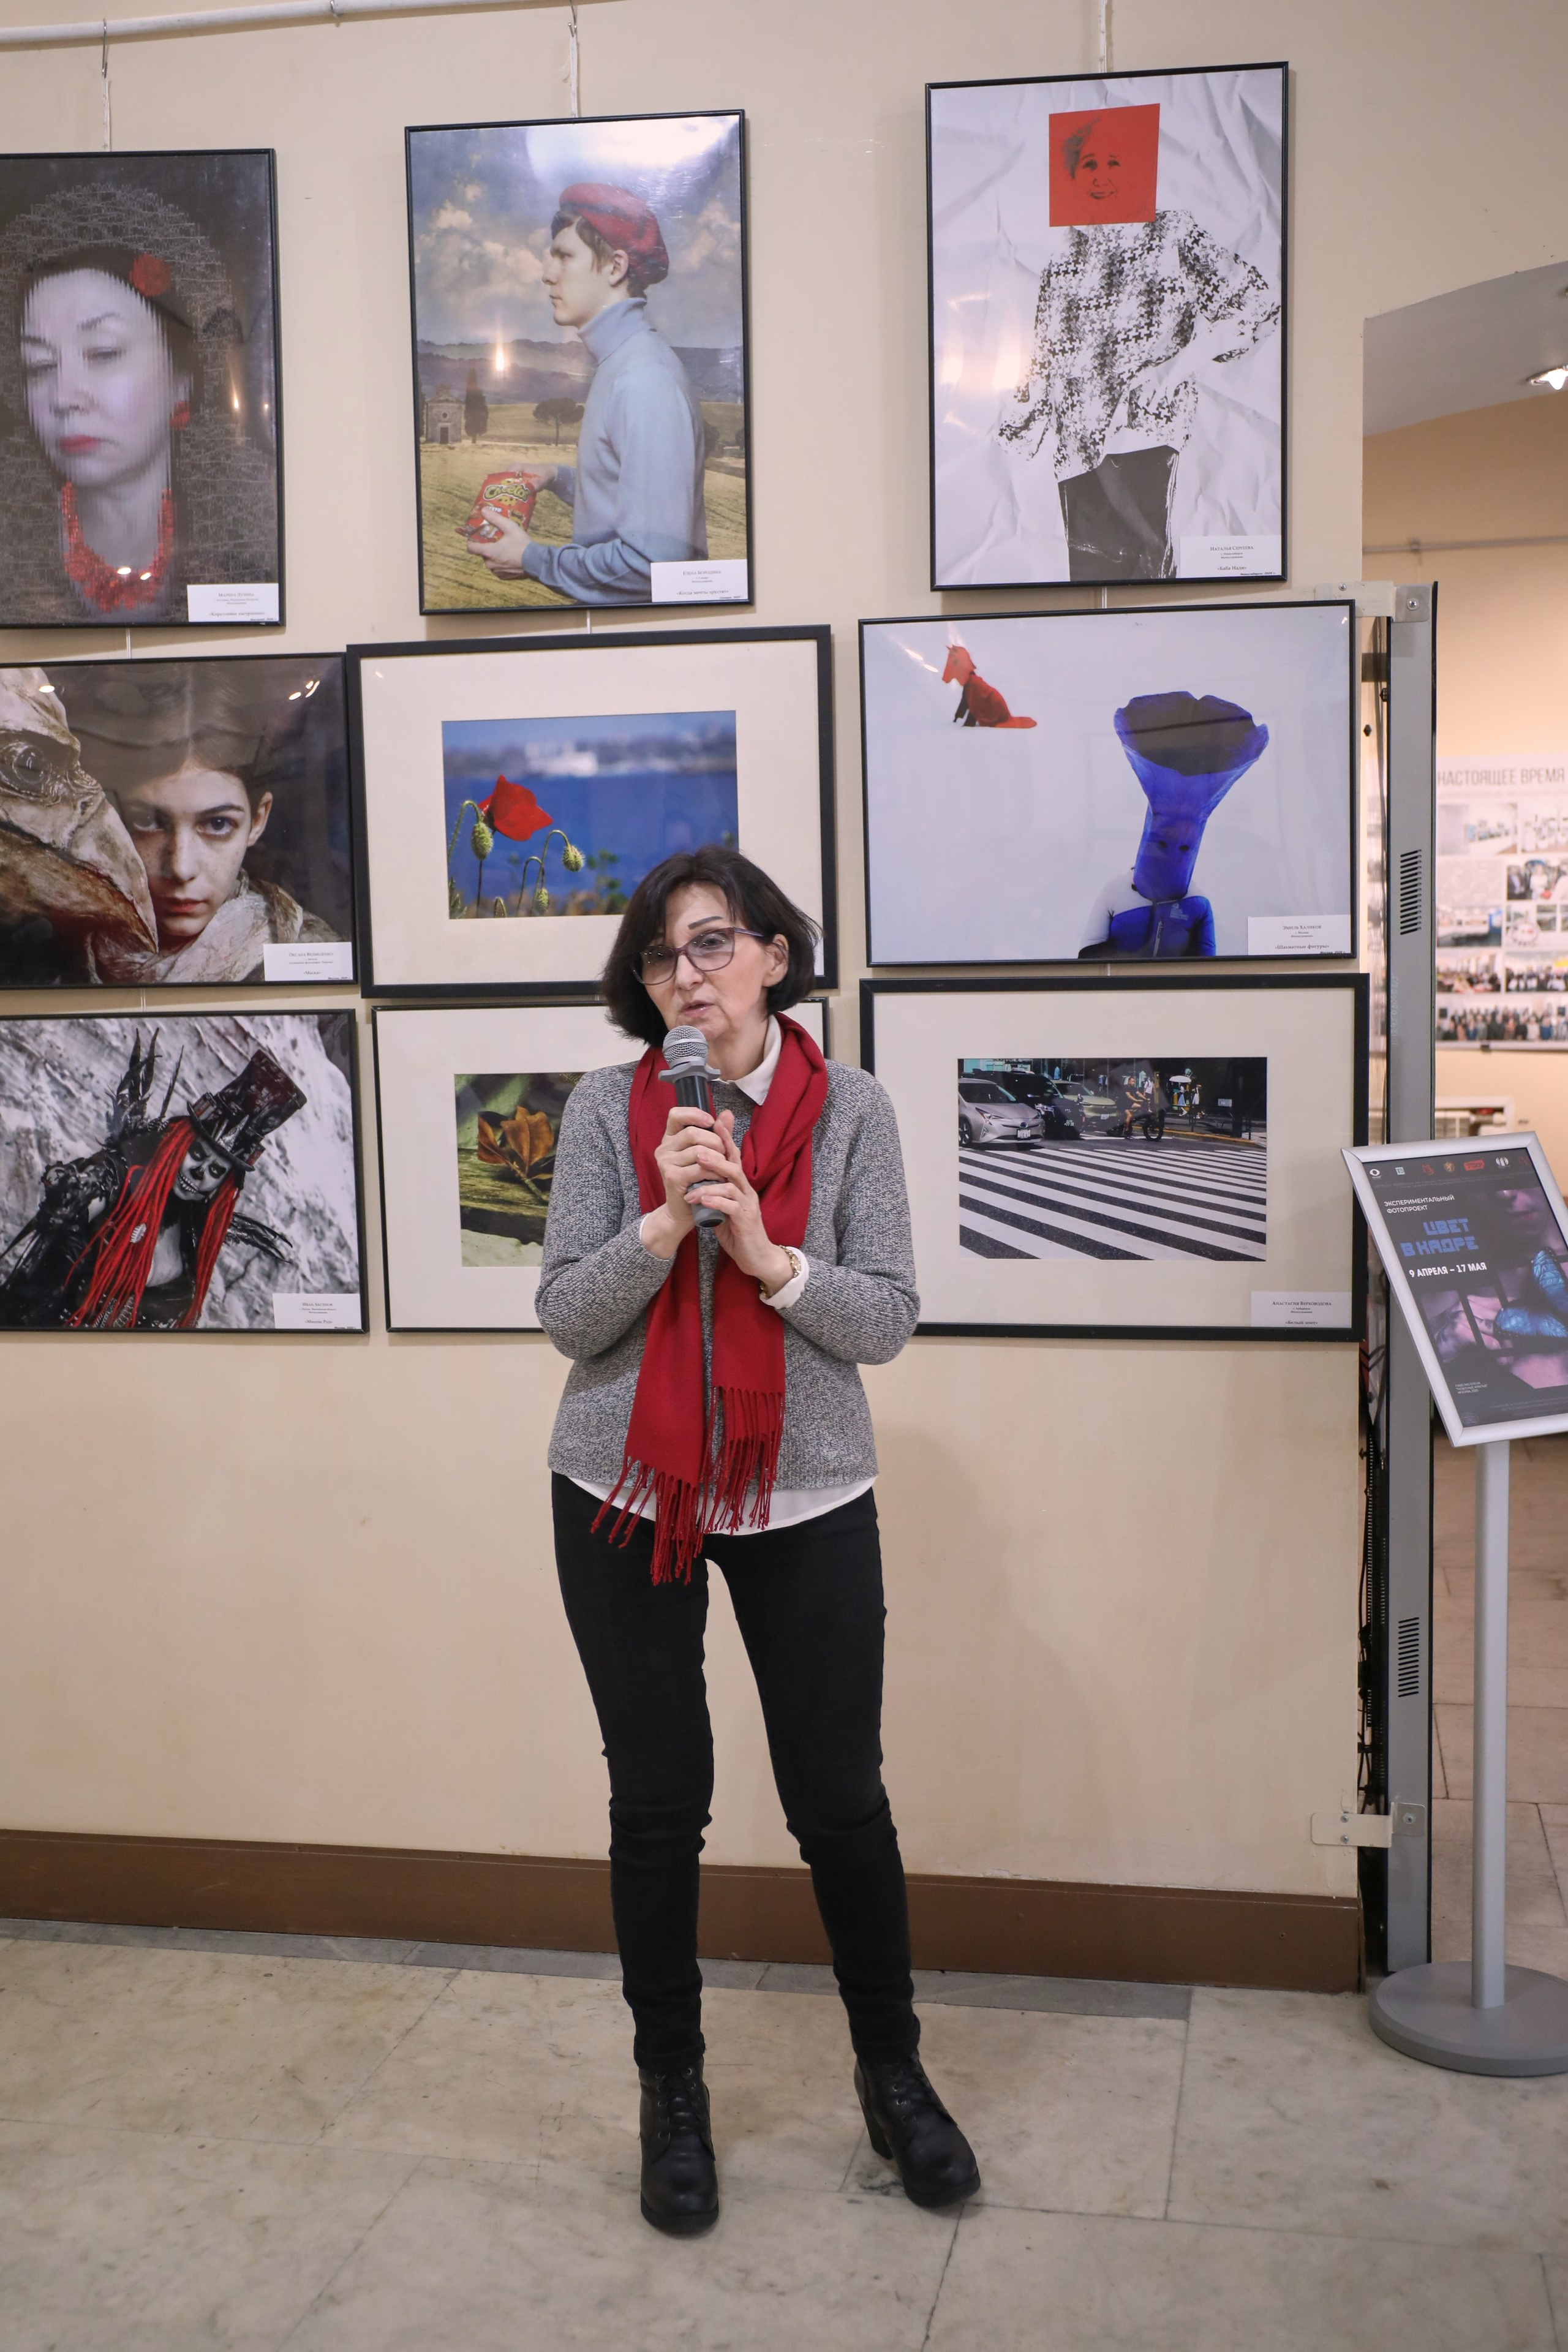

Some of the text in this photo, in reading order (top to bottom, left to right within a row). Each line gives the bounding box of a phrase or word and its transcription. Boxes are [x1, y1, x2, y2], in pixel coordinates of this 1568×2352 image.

[1437, 767, 1565, 786] НАСТОЯЩЕЕ ВРЕМЯ
[1384, 1194, 1455, 1207] ЭКСПЕРИМЕНТАЛЬНЫЙ
[1387, 1205, 1428, 1213] ФОТОПРОЕКТ
[1423, 1218, 1469, 1235] ЦВЕТ
[1400, 1236, 1479, 1257] В КАДРЕ
[1417, 1266, 1448, 1277] АПРЕЛЯ
[1456, 1264, 1466, 1273] 17
[1468, 1262, 1487, 1272] МАЯ
